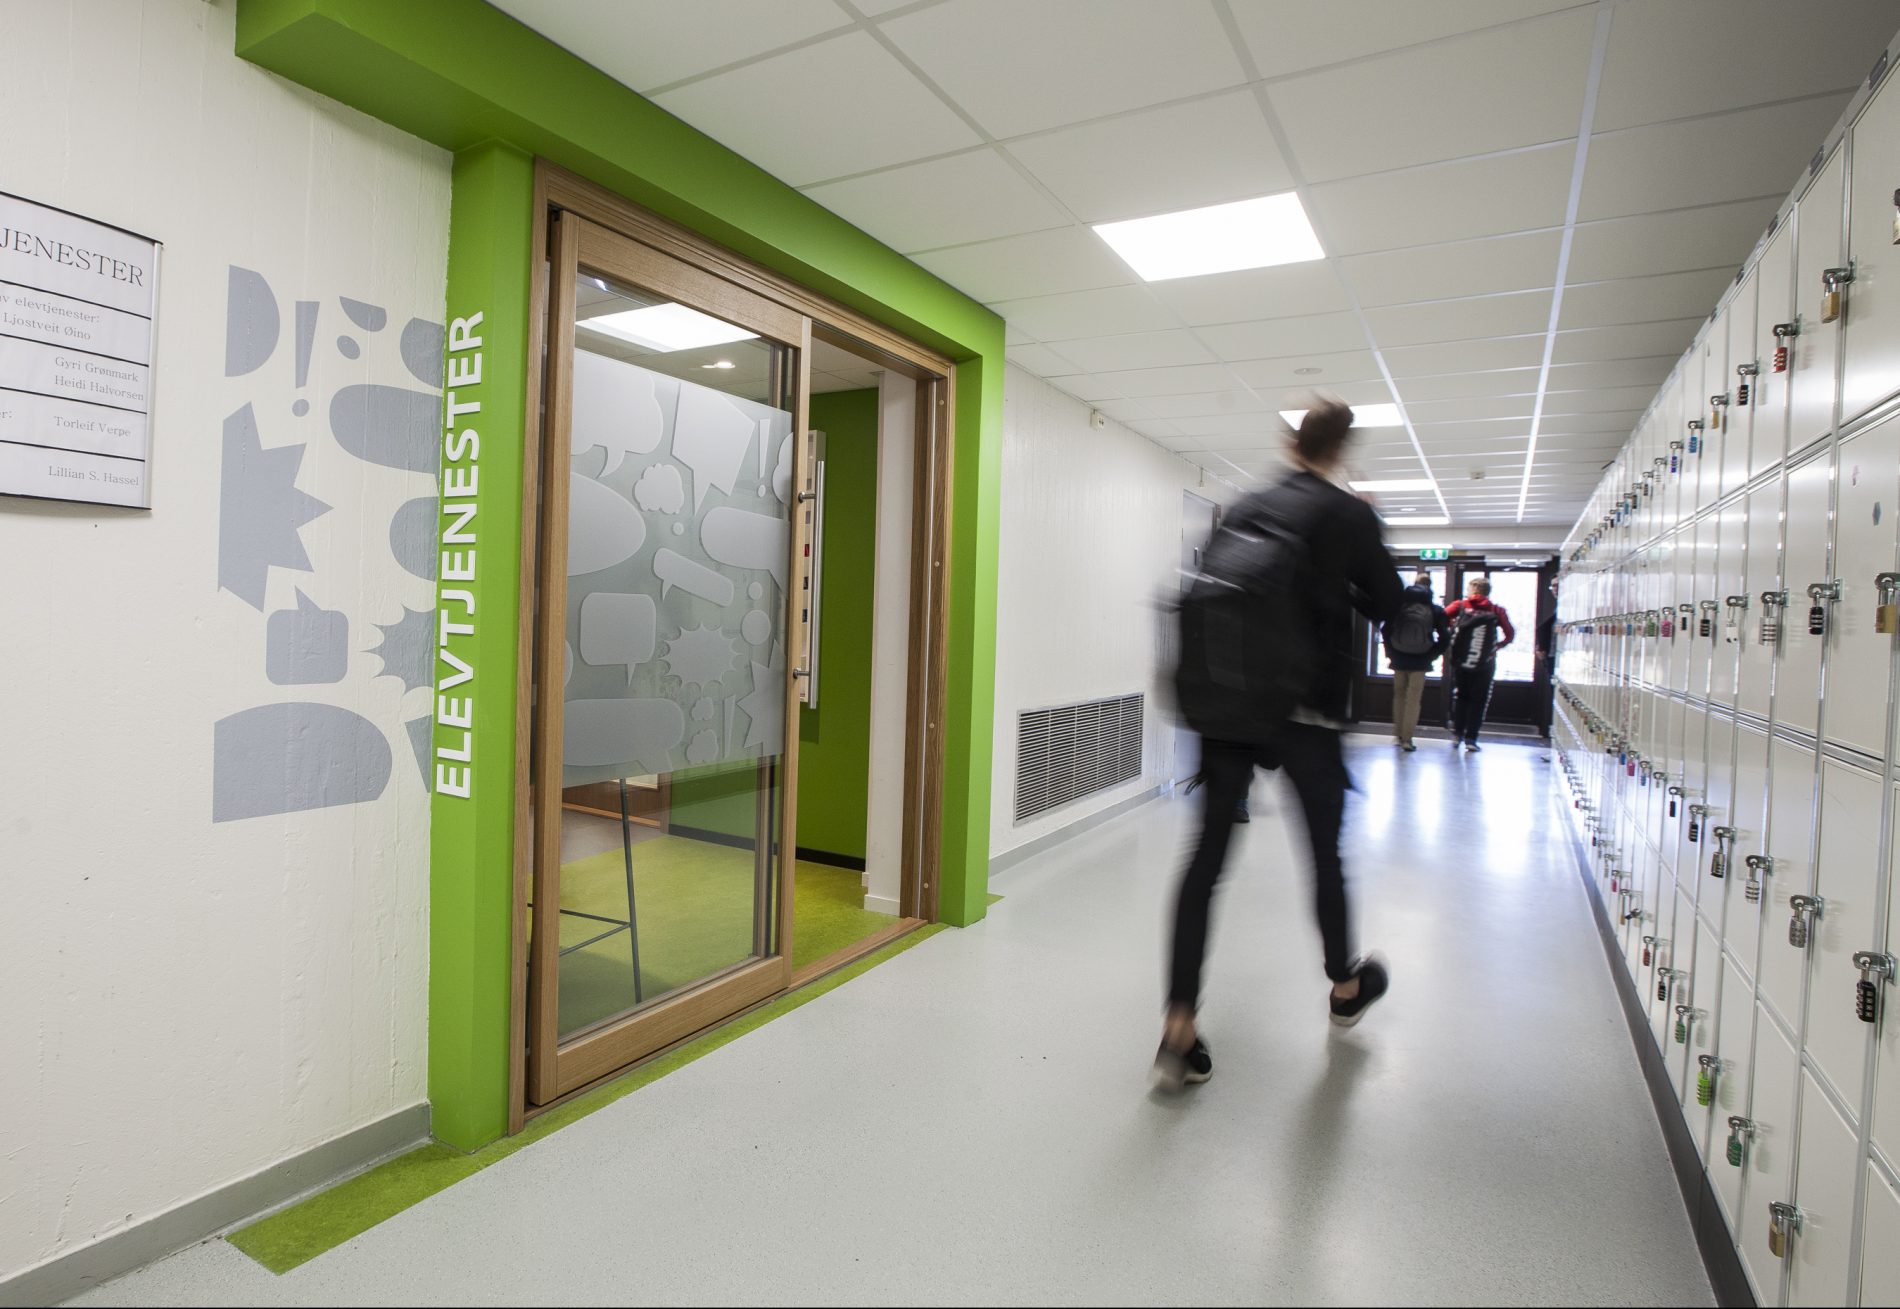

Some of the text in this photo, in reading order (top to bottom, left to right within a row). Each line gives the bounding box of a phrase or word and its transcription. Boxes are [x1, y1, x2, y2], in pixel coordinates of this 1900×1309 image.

[15, 297, 100, 323] elevtjenester:
[4, 312, 91, 340] Ljostveit Øino
[55, 356, 139, 382] Gyri Grønmark
[54, 375, 144, 401] Heidi Halvorsen
[54, 415, 131, 437] Torleif Verpe
[48, 466, 139, 486] Lillian S. Hassel
[436, 310, 484, 799] ELEVTJENESTER
